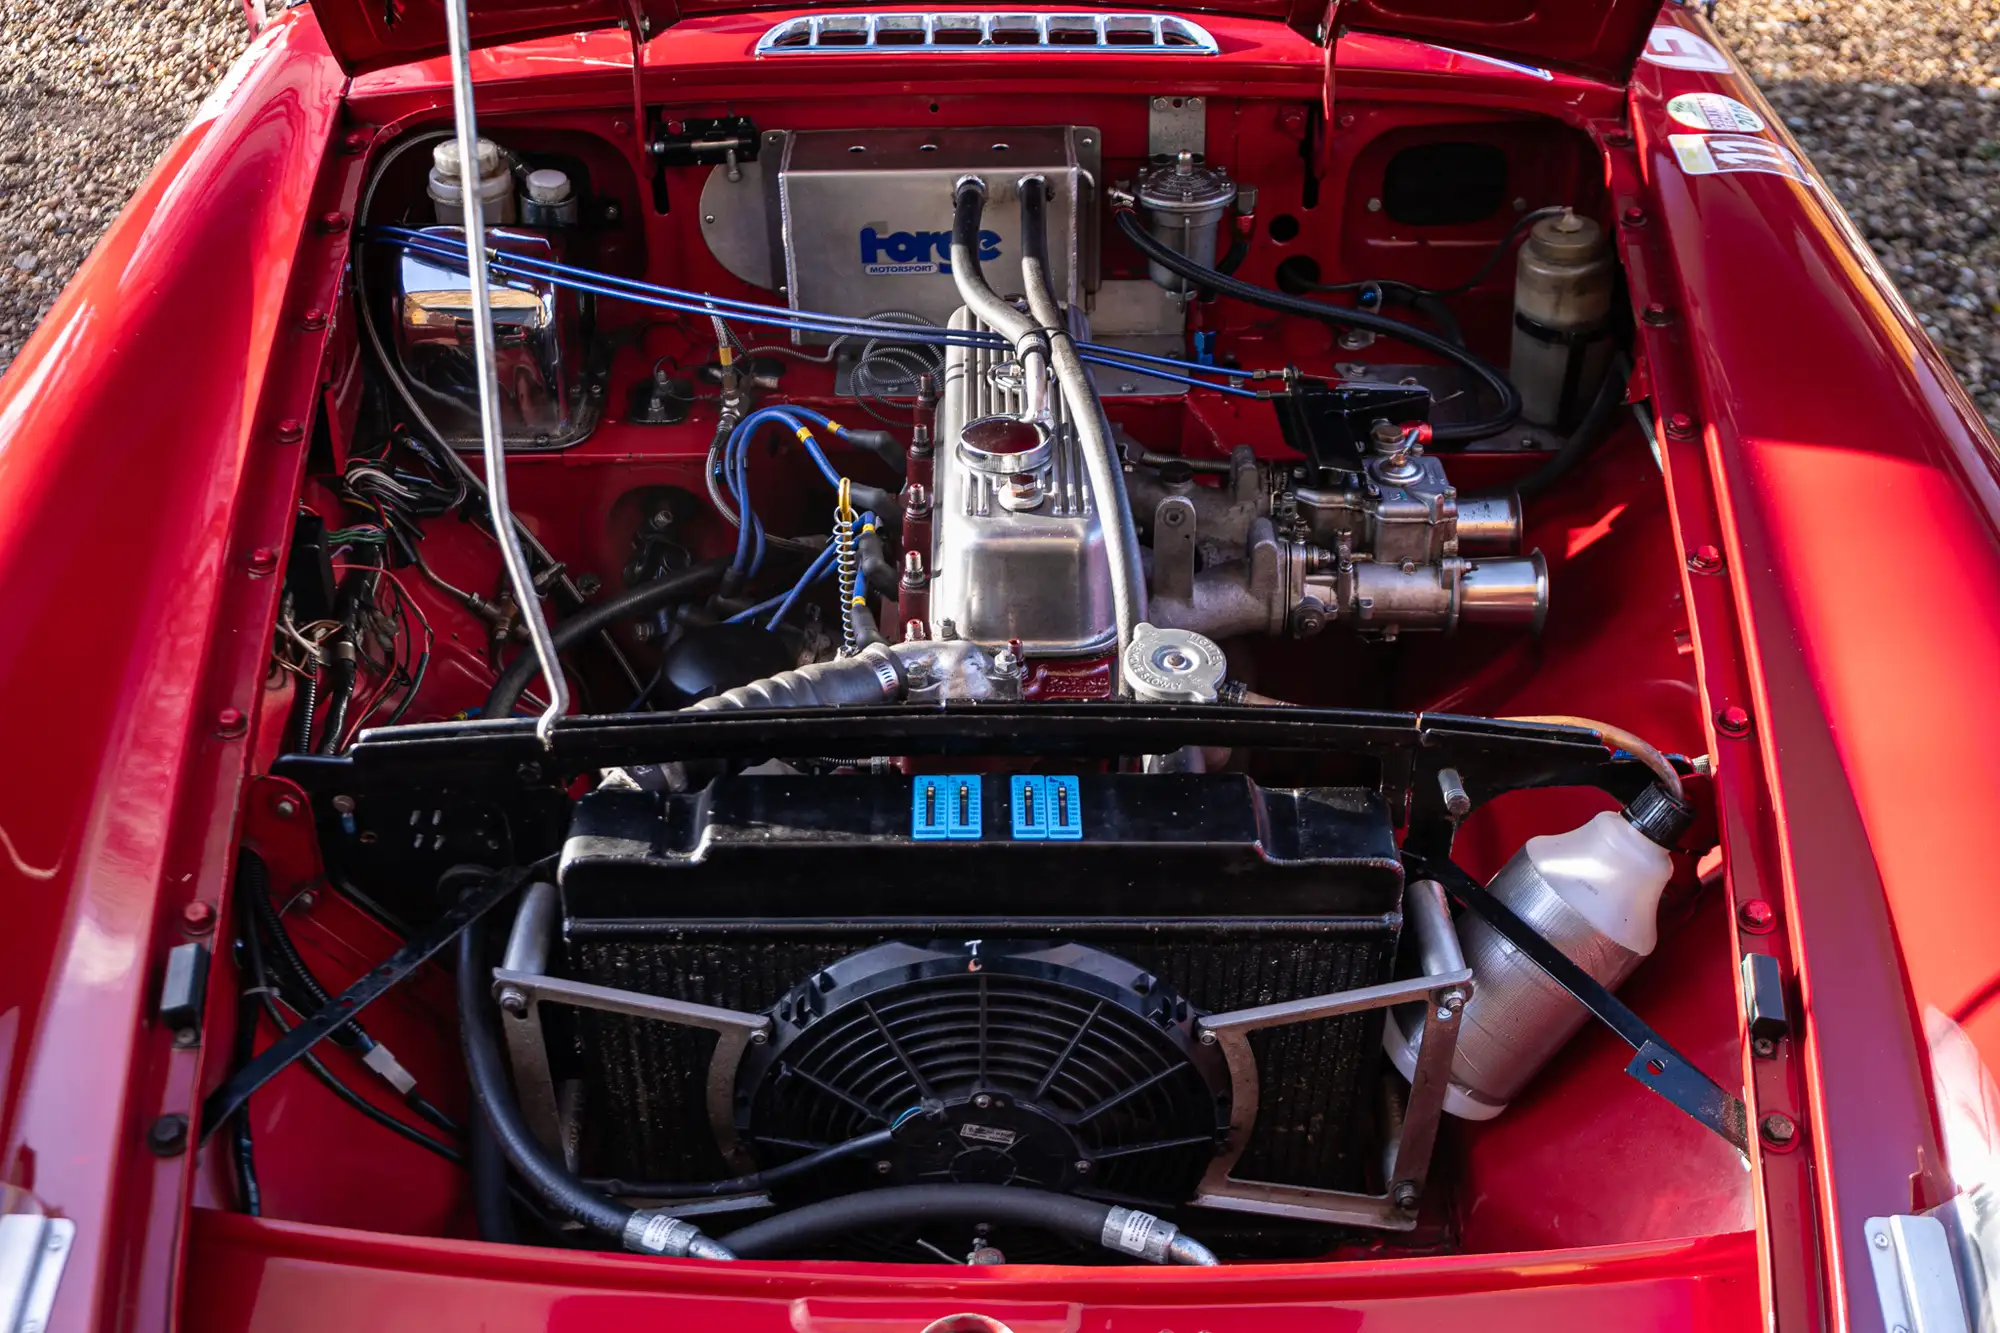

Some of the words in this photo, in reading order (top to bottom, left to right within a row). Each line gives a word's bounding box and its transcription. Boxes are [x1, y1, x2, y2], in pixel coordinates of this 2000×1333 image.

[869, 265, 933, 273] MOTORSPORT
[1128, 642, 1145, 673] REMOVE
[1141, 672, 1182, 690] SLOWLY
